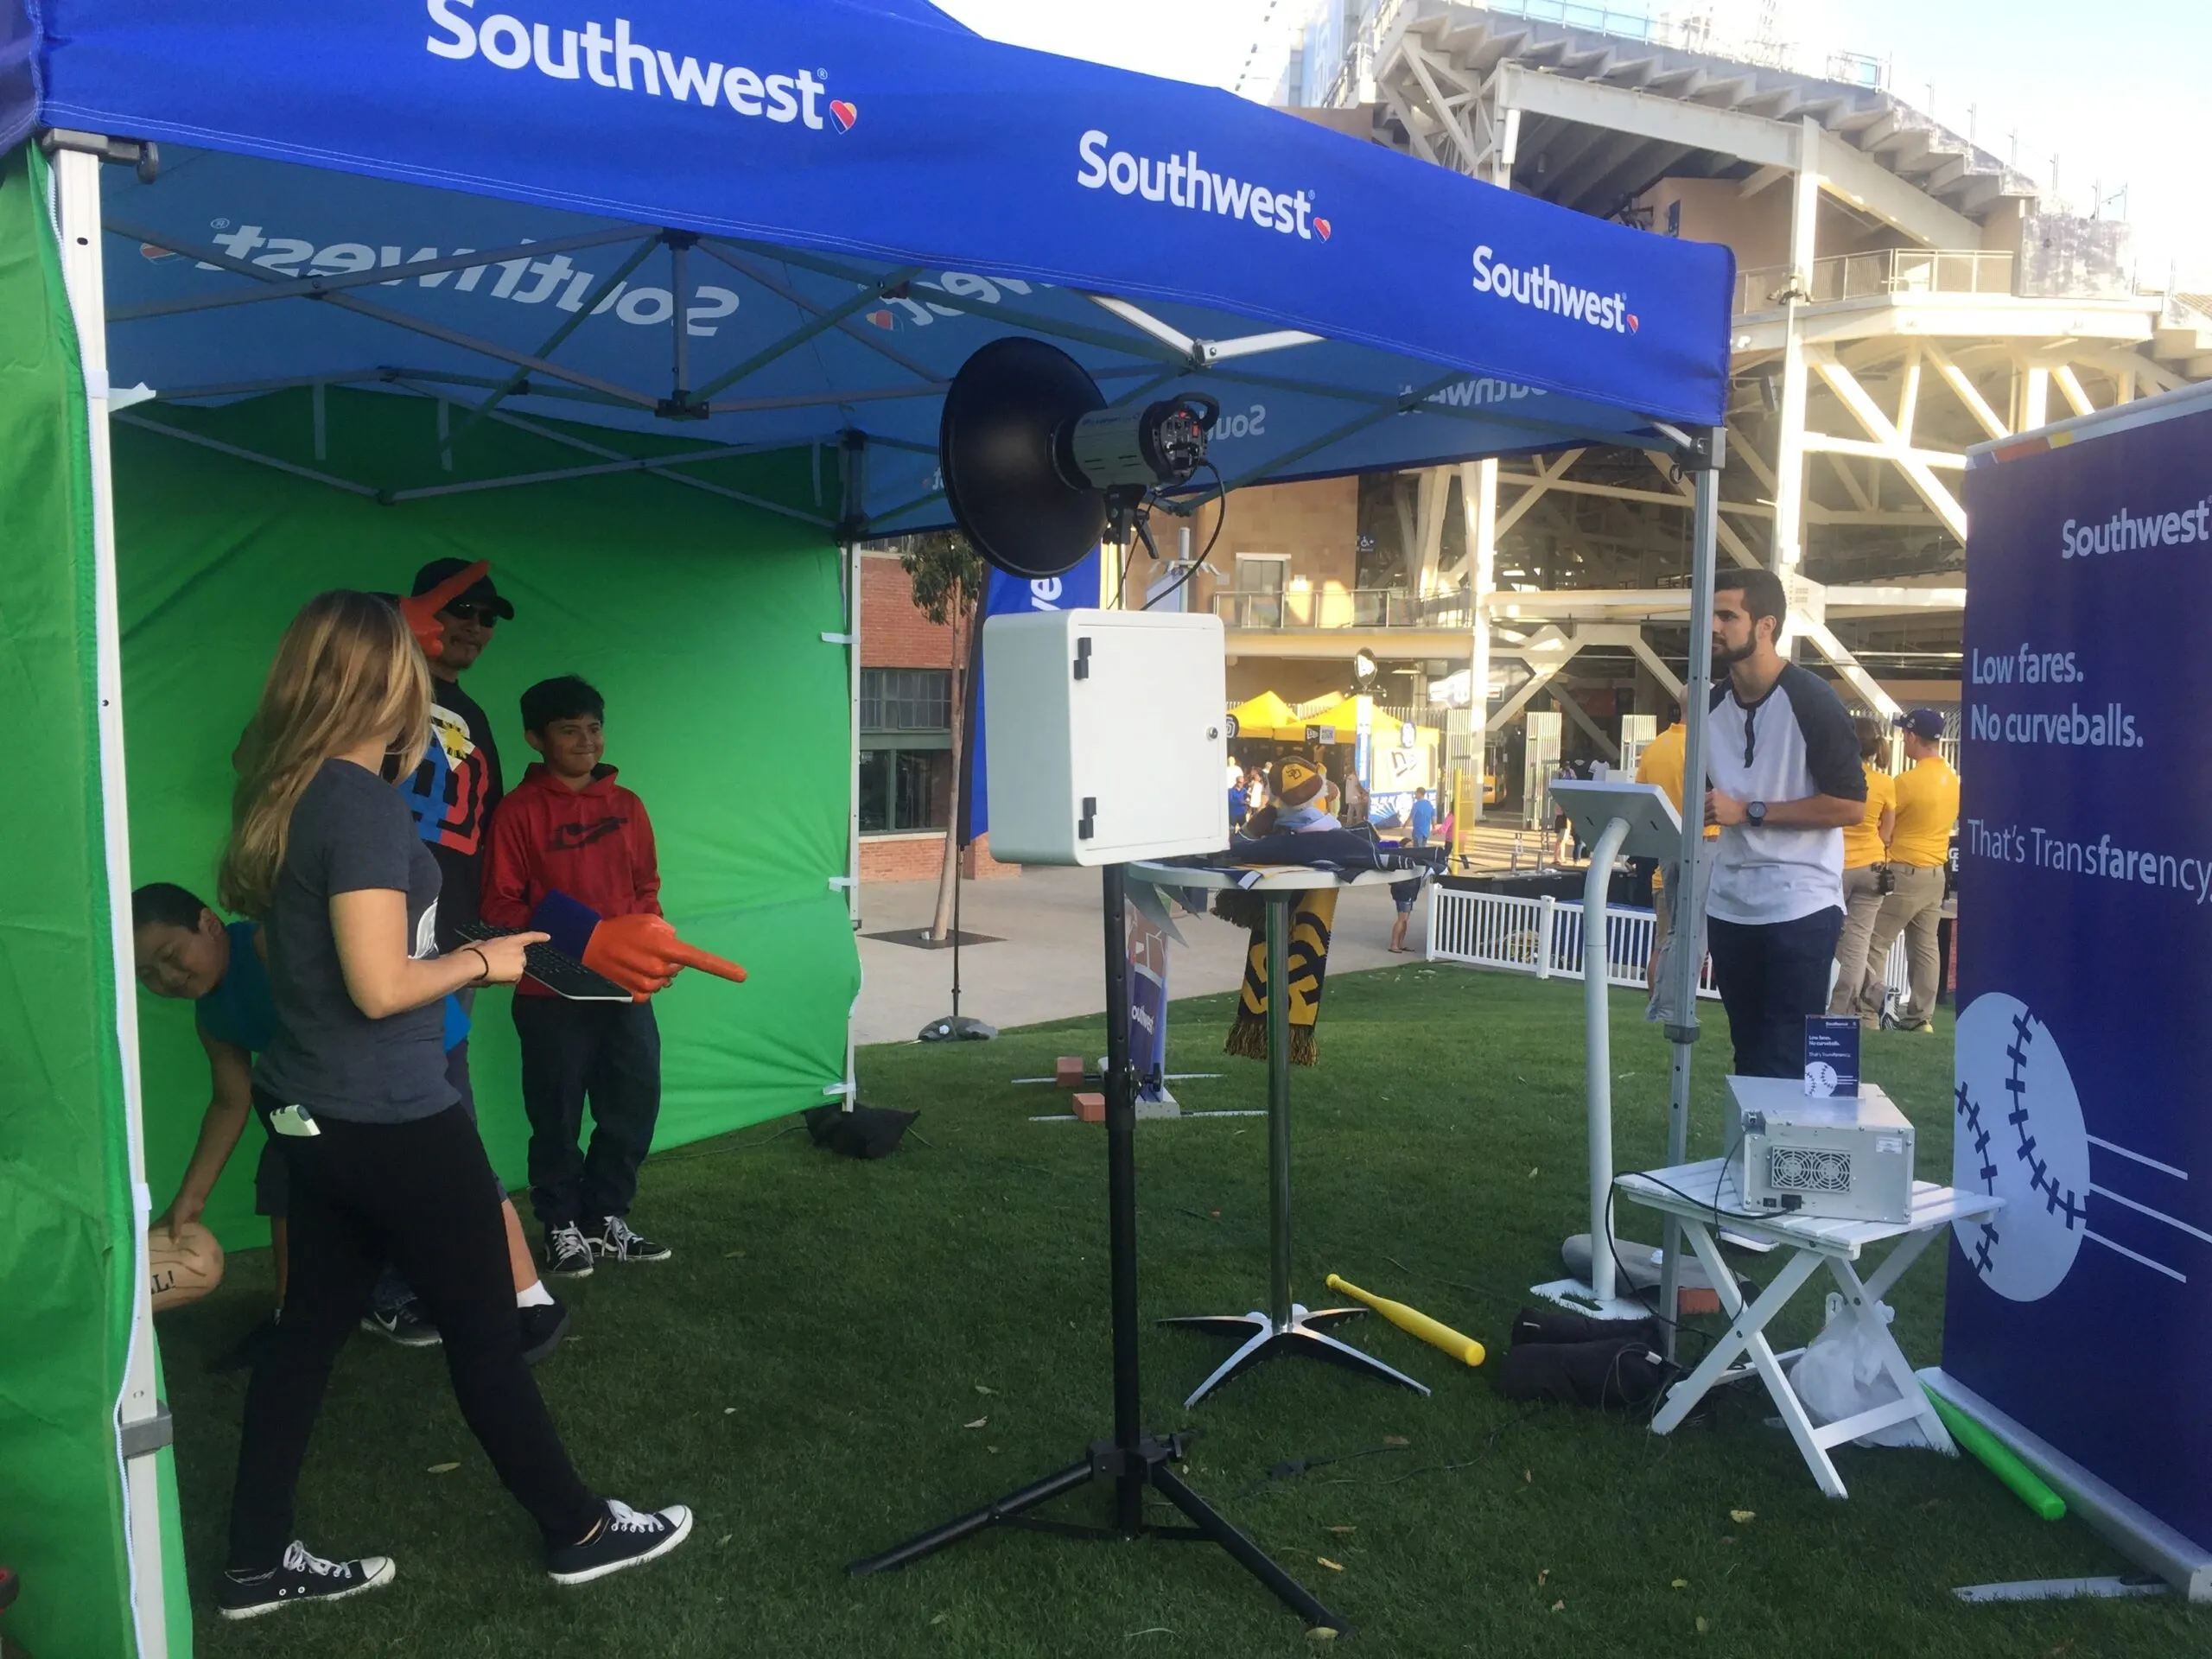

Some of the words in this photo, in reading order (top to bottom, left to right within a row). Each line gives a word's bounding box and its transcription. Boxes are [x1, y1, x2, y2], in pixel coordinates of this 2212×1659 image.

[426, 0, 824, 130] Southwest
[1077, 130, 1312, 240] Southwest
[1472, 245, 1625, 334] Southwest
[2062, 500, 2209, 559] Southwest
[1972, 648, 2014, 684] Low
[2018, 642, 2084, 683] fares.
[1971, 703, 2001, 741] No
[2005, 702, 2144, 747] curveballs.
[1967, 818, 2025, 863] That's
